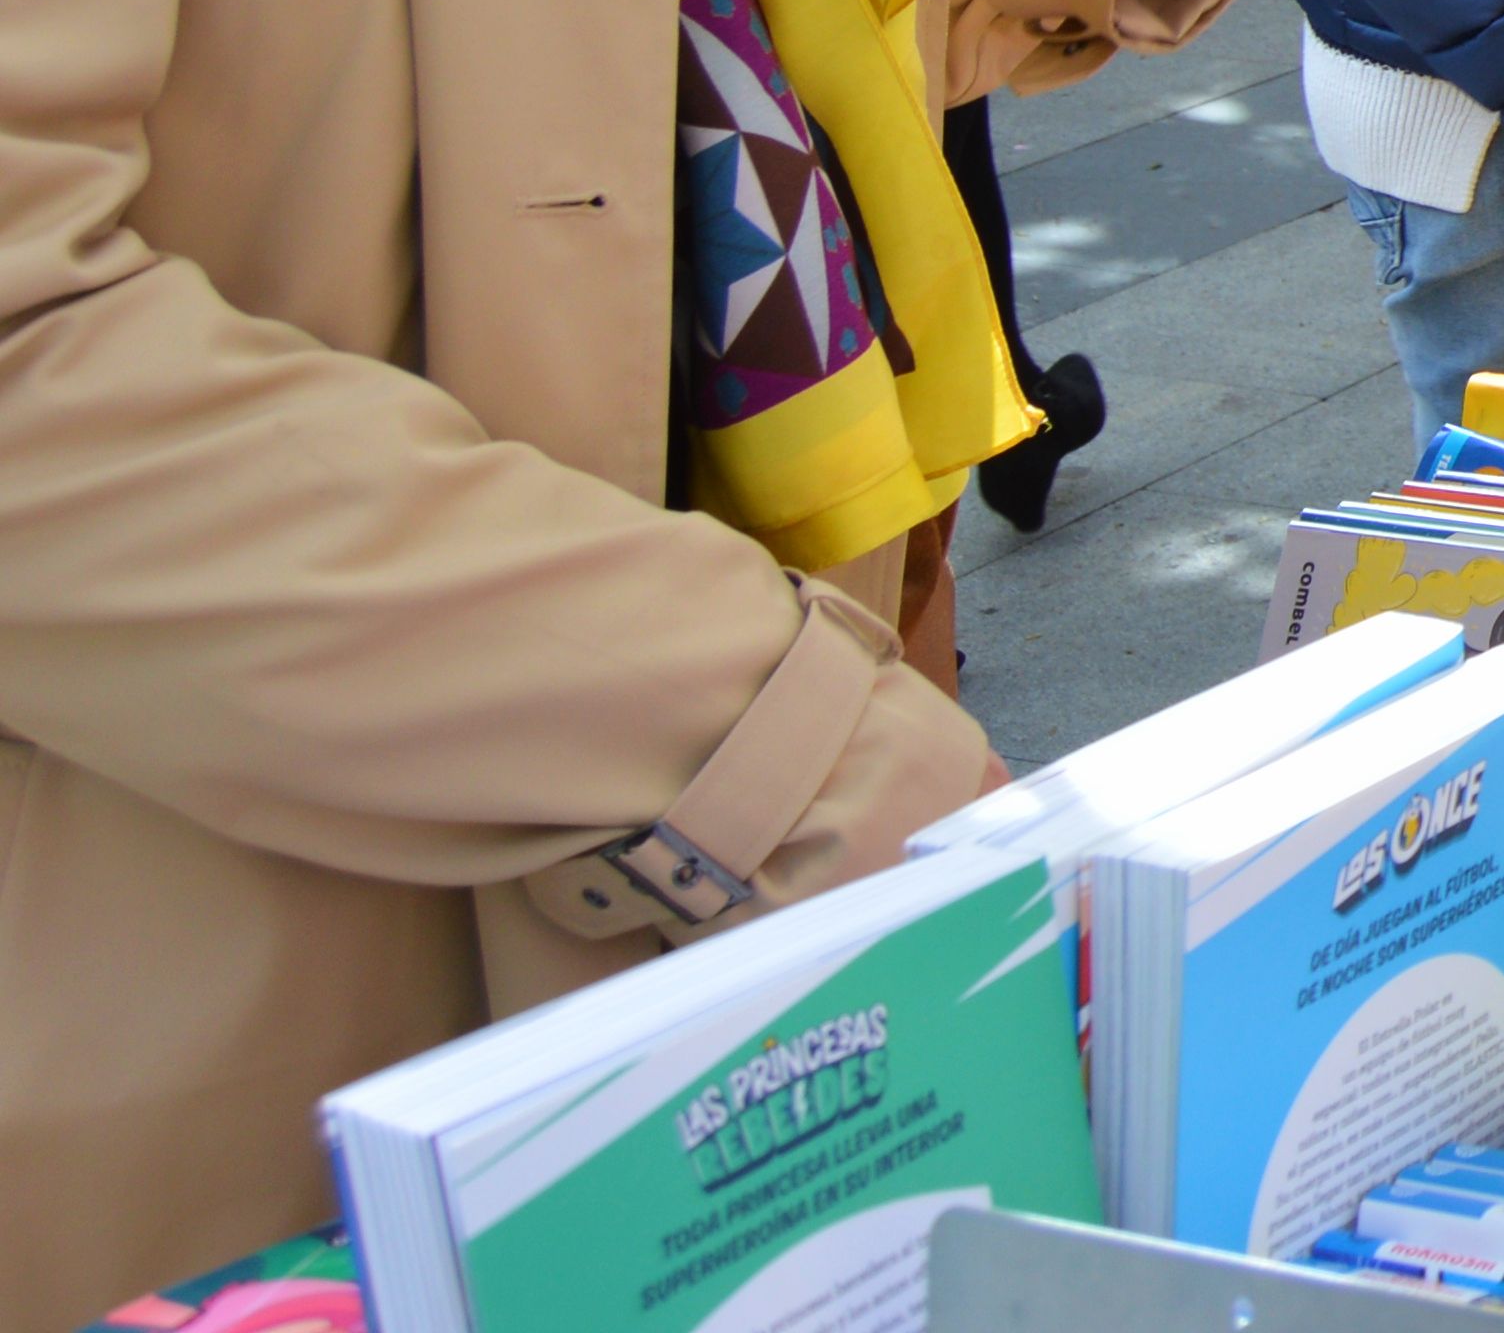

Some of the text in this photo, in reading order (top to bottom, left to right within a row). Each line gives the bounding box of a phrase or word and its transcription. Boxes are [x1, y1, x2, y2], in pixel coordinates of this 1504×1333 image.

[1296, 981, 1318, 1010] DE
[1320, 953, 1375, 998] NOCHE
[1375, 935, 1409, 974] SON
[1309, 945, 1332, 974] DE
[1333, 923, 1362, 962] DÍA
[1362, 896, 1424, 948] JUEGAN
[1423, 882, 1444, 913] AL
[675, 1002, 889, 1154] LAS PRINCESAS
[725, 1150, 831, 1223] PRINCESA
[831, 1114, 894, 1166] LLEVA
